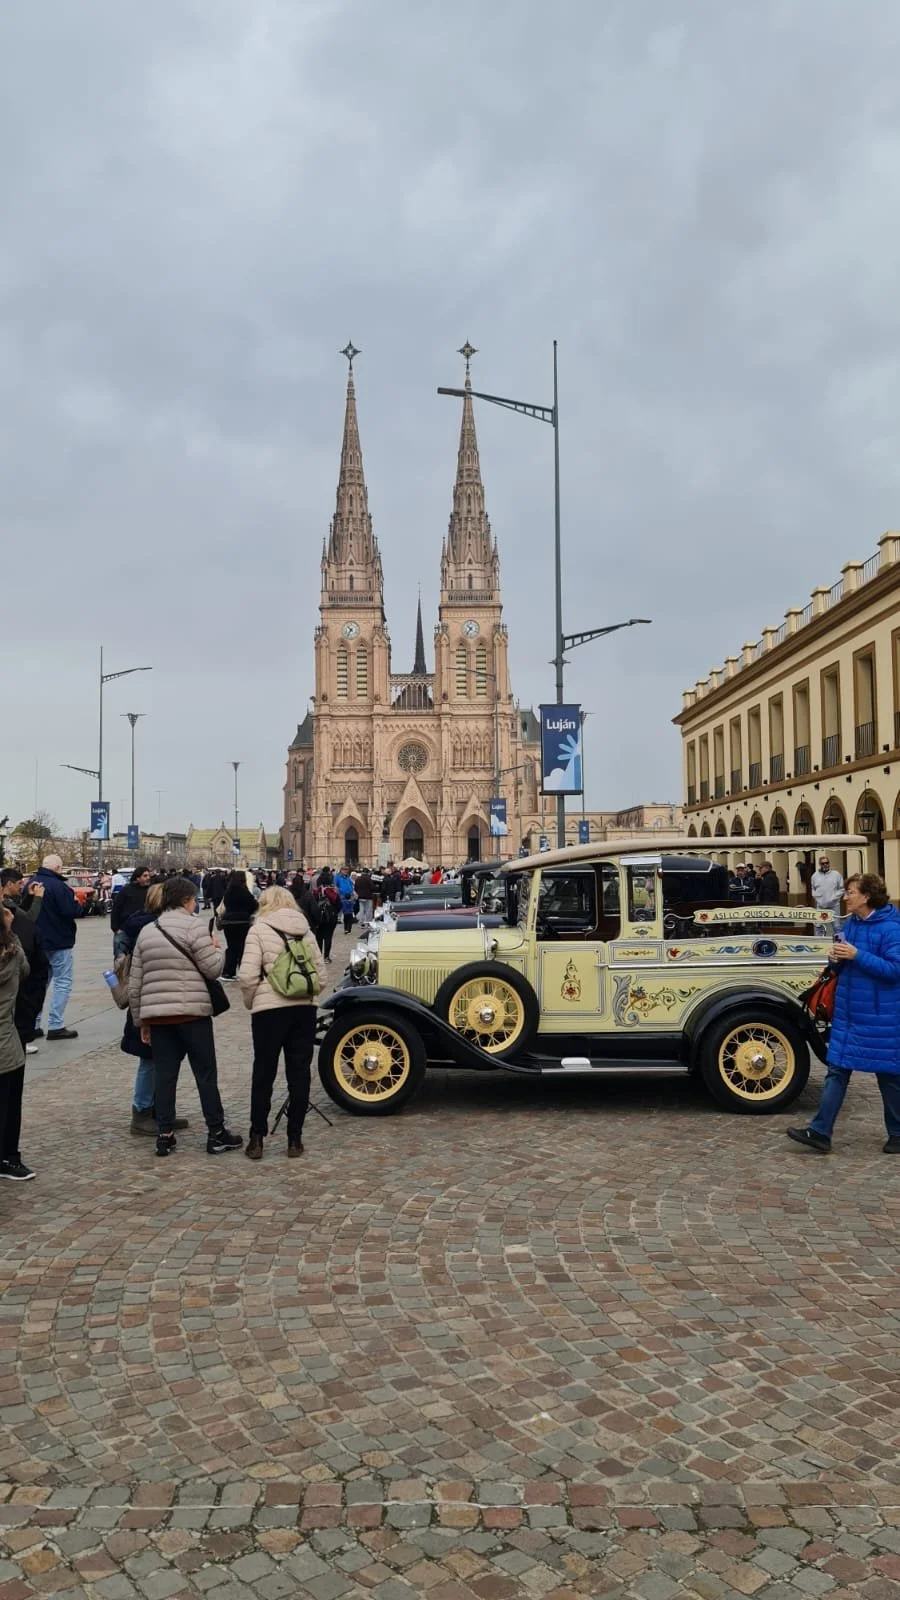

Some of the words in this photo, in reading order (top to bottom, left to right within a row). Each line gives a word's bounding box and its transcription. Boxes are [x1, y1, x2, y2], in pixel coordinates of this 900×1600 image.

[546, 718, 576, 732] Luján
[743, 910, 770, 919] QUISO
[773, 910, 785, 919] LA
[788, 910, 817, 920] SUERTE
